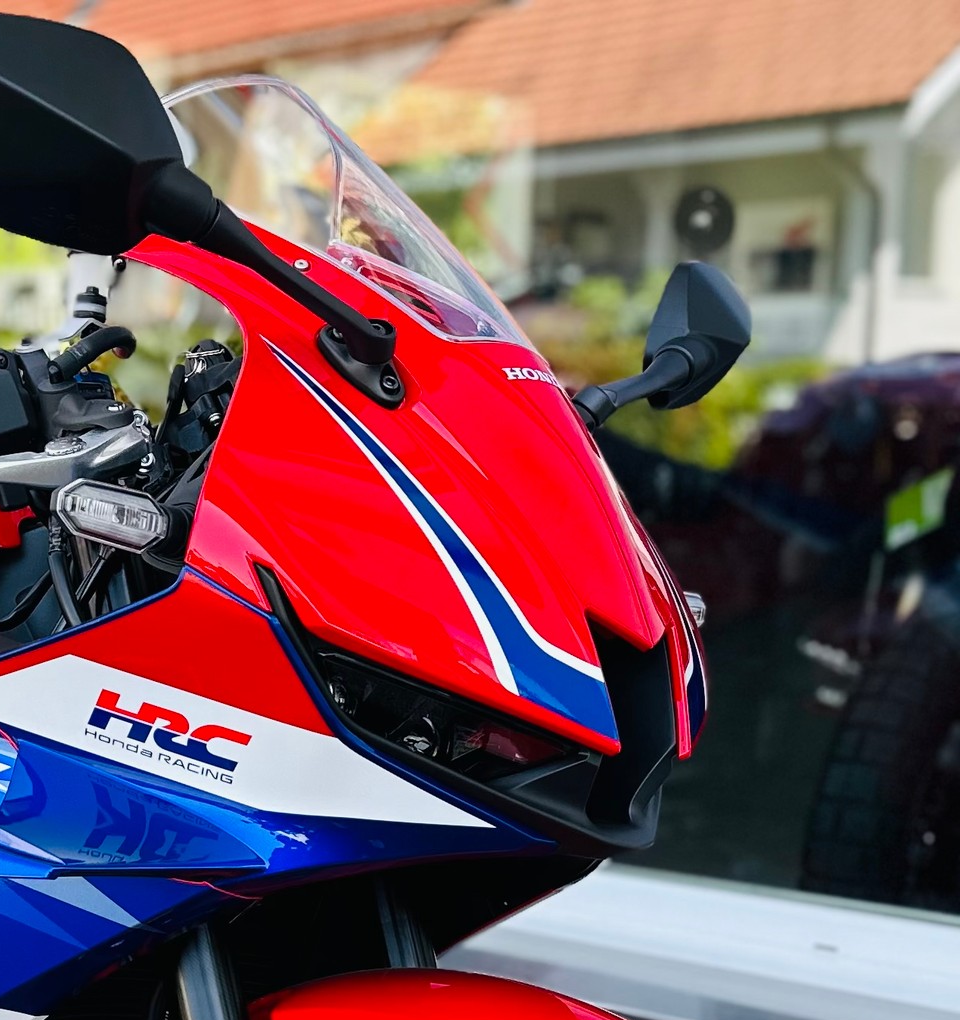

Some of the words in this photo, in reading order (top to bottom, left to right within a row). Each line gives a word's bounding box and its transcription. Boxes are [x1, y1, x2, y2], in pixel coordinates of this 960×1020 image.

[84, 728, 153, 758] Honda
[158, 752, 234, 784] RACING
[87, 688, 252, 772] HRC
